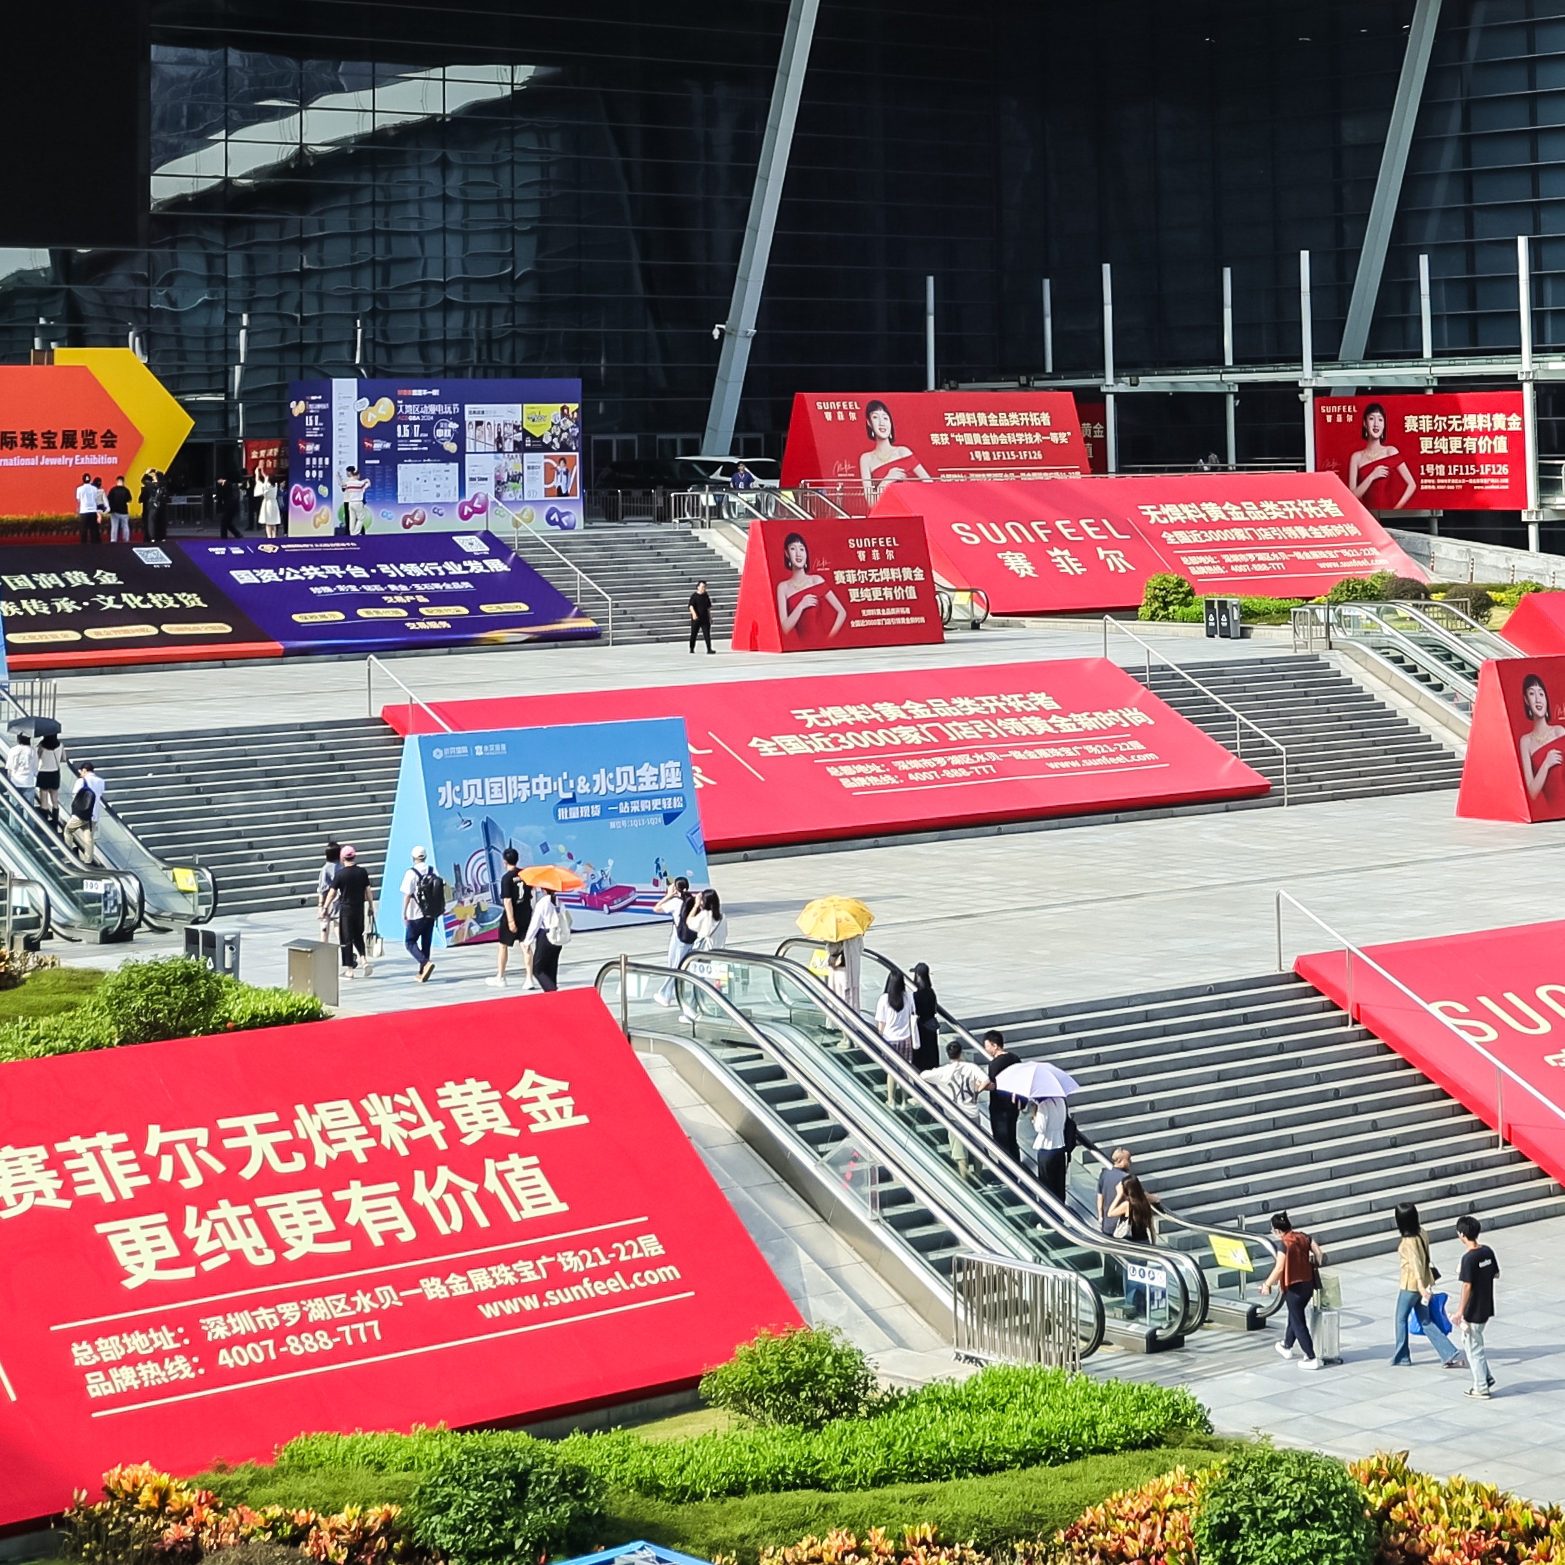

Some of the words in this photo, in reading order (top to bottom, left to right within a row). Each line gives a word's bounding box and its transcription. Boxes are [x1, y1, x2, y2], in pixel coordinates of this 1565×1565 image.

[816, 401, 860, 412] SUNFEEL
[1321, 405, 1358, 414] SUNFEEL
[944, 412, 1051, 427] 无焊料黄金品类开拓者
[1404, 413, 1522, 433] 赛菲尔无焊料黄金
[1419, 435, 1508, 454] 更纯更有价值
[39, 455, 73, 467] Jewelry
[75, 454, 118, 466] Exhibition
[970, 450, 991, 462] 1号馆
[992, 450, 1043, 461] 1F115-1F126
[1419, 464, 1446, 476] 1号馆
[1448, 464, 1509, 476] 1F115-1F126
[1138, 498, 1345, 525] 无焊料黄金品类开拓者
[951, 517, 1131, 545] SUNFEEL
[1161, 523, 1362, 545] 全国近3000家门店引领黄金新时尚
[848, 537, 899, 549] SUNFEEL
[857, 549, 895, 562] 赛菲尔
[997, 546, 1135, 579] 赛菲尔
[229, 558, 511, 586] 国资公共平台·引领行业发展
[834, 567, 925, 585] 赛菲尔无焊料黄金
[848, 586, 917, 603] 更纯更有价值
[791, 691, 1062, 731] 无焊料黄金品类开拓者
[748, 707, 1155, 760] 全国近3000家门店引领黄金新时尚
[1046, 751, 1160, 772] www.sunfeel.com
[438, 760, 683, 809] 水贝国际中心&水贝金座
[557, 803, 601, 821] 批量现货
[608, 797, 684, 815] 一站采购更轻松
[95, 1152, 569, 1290] 更纯更有价值
[70, 1232, 666, 1369] 总部地址：深圳市罗湖区水贝一路金展珠宝广场21-22层
[83, 1319, 384, 1402] 品牌热线：4007-888-777
[478, 1260, 681, 1321] www.sunfeel.com
